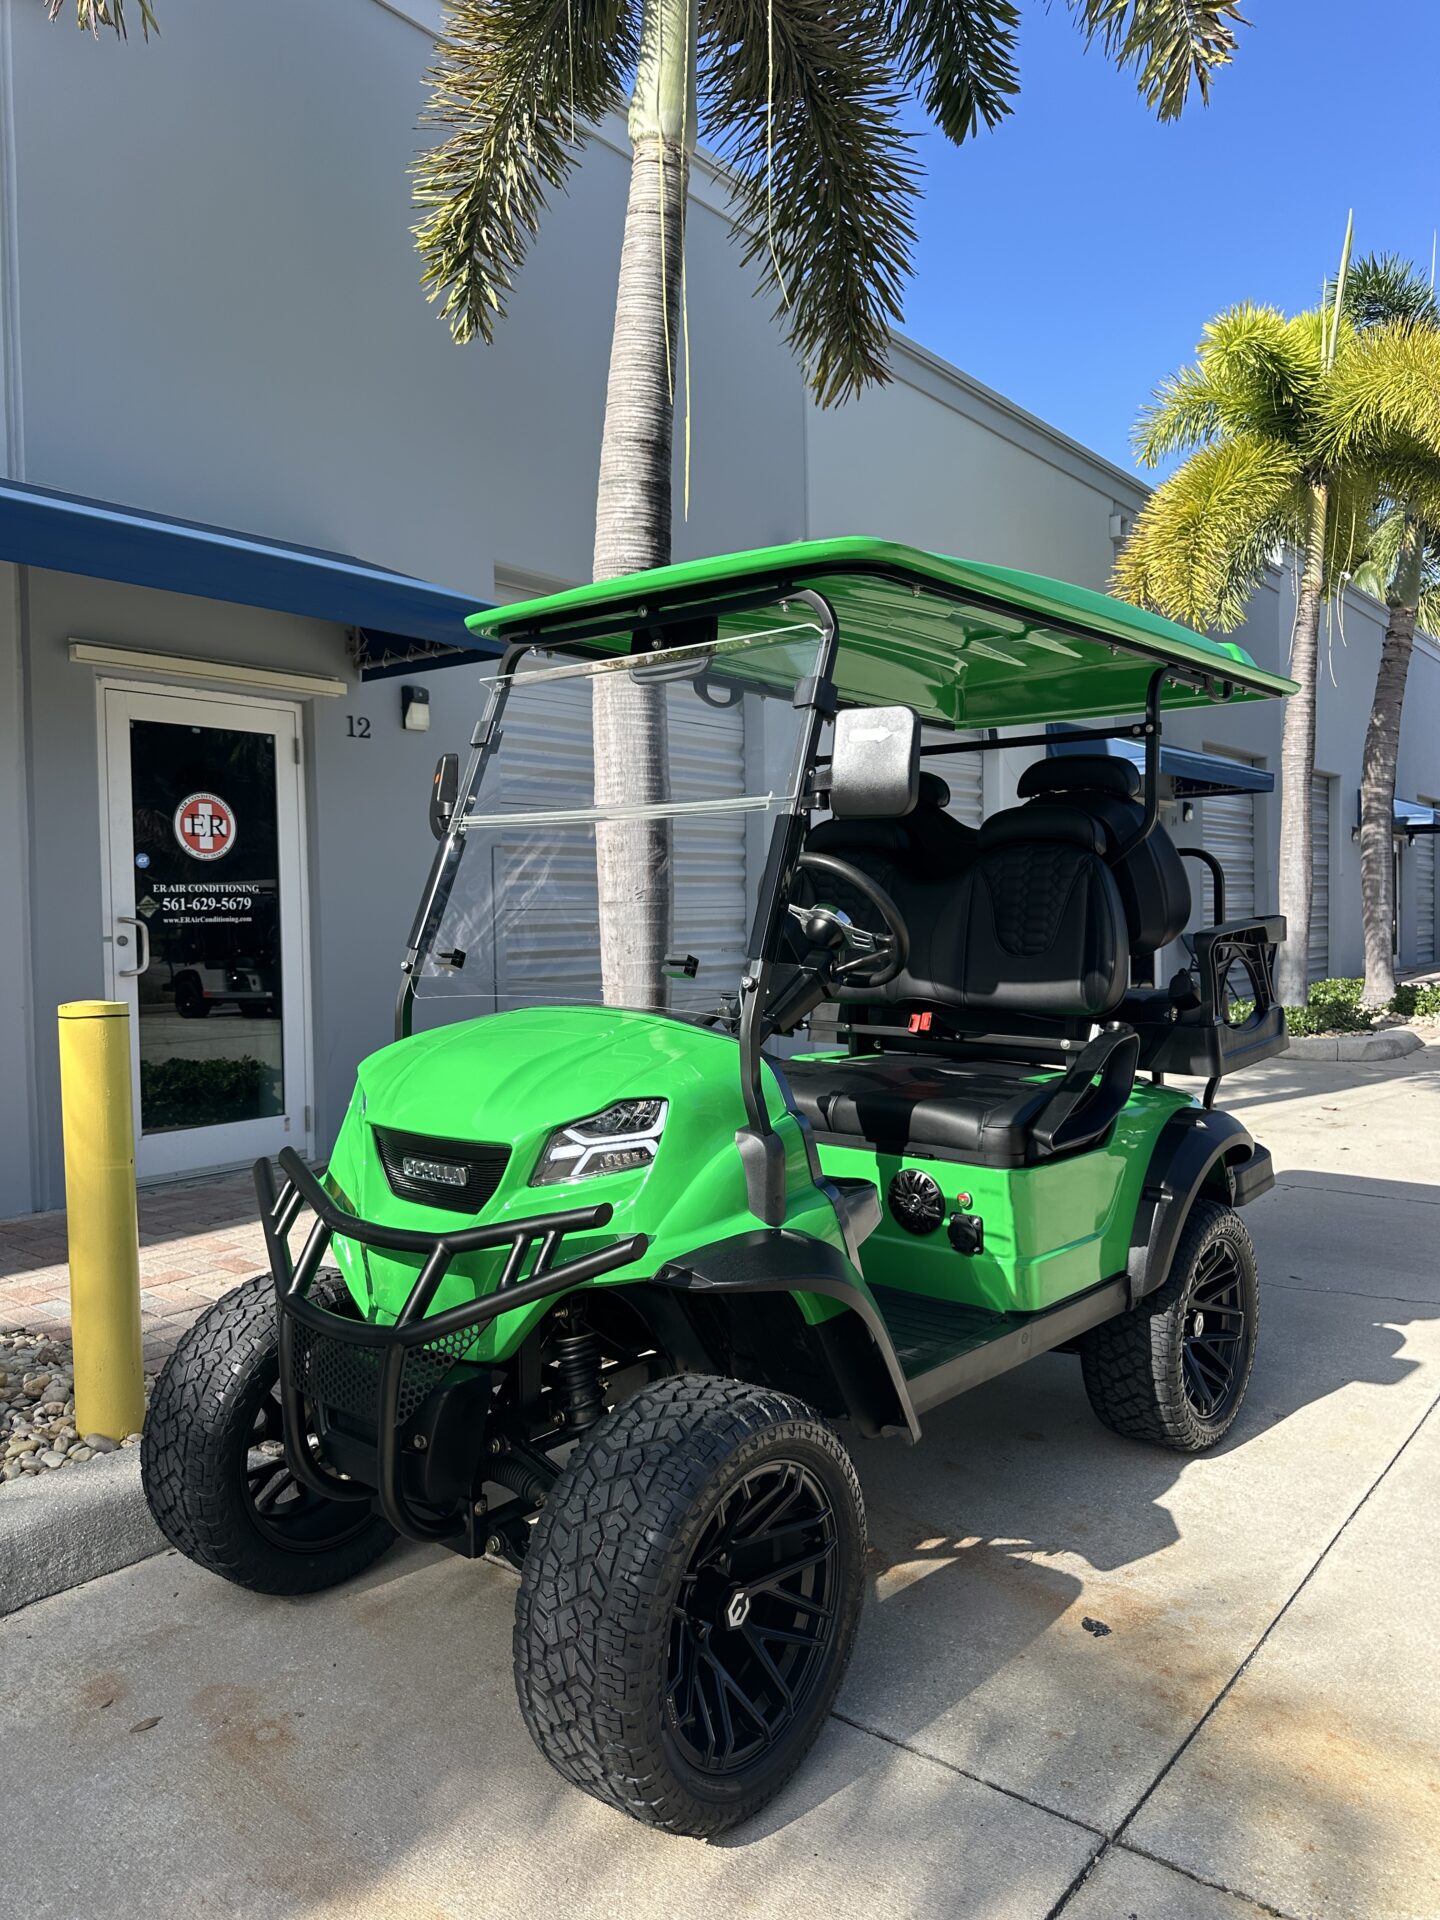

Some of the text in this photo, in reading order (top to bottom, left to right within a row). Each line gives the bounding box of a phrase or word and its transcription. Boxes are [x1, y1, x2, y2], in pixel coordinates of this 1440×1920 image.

[346, 715, 371, 739] 12
[189, 814, 227, 838] ER
[153, 884, 259, 893] ER AIR CONDITIONING
[162, 897, 252, 911] 561-629-5679
